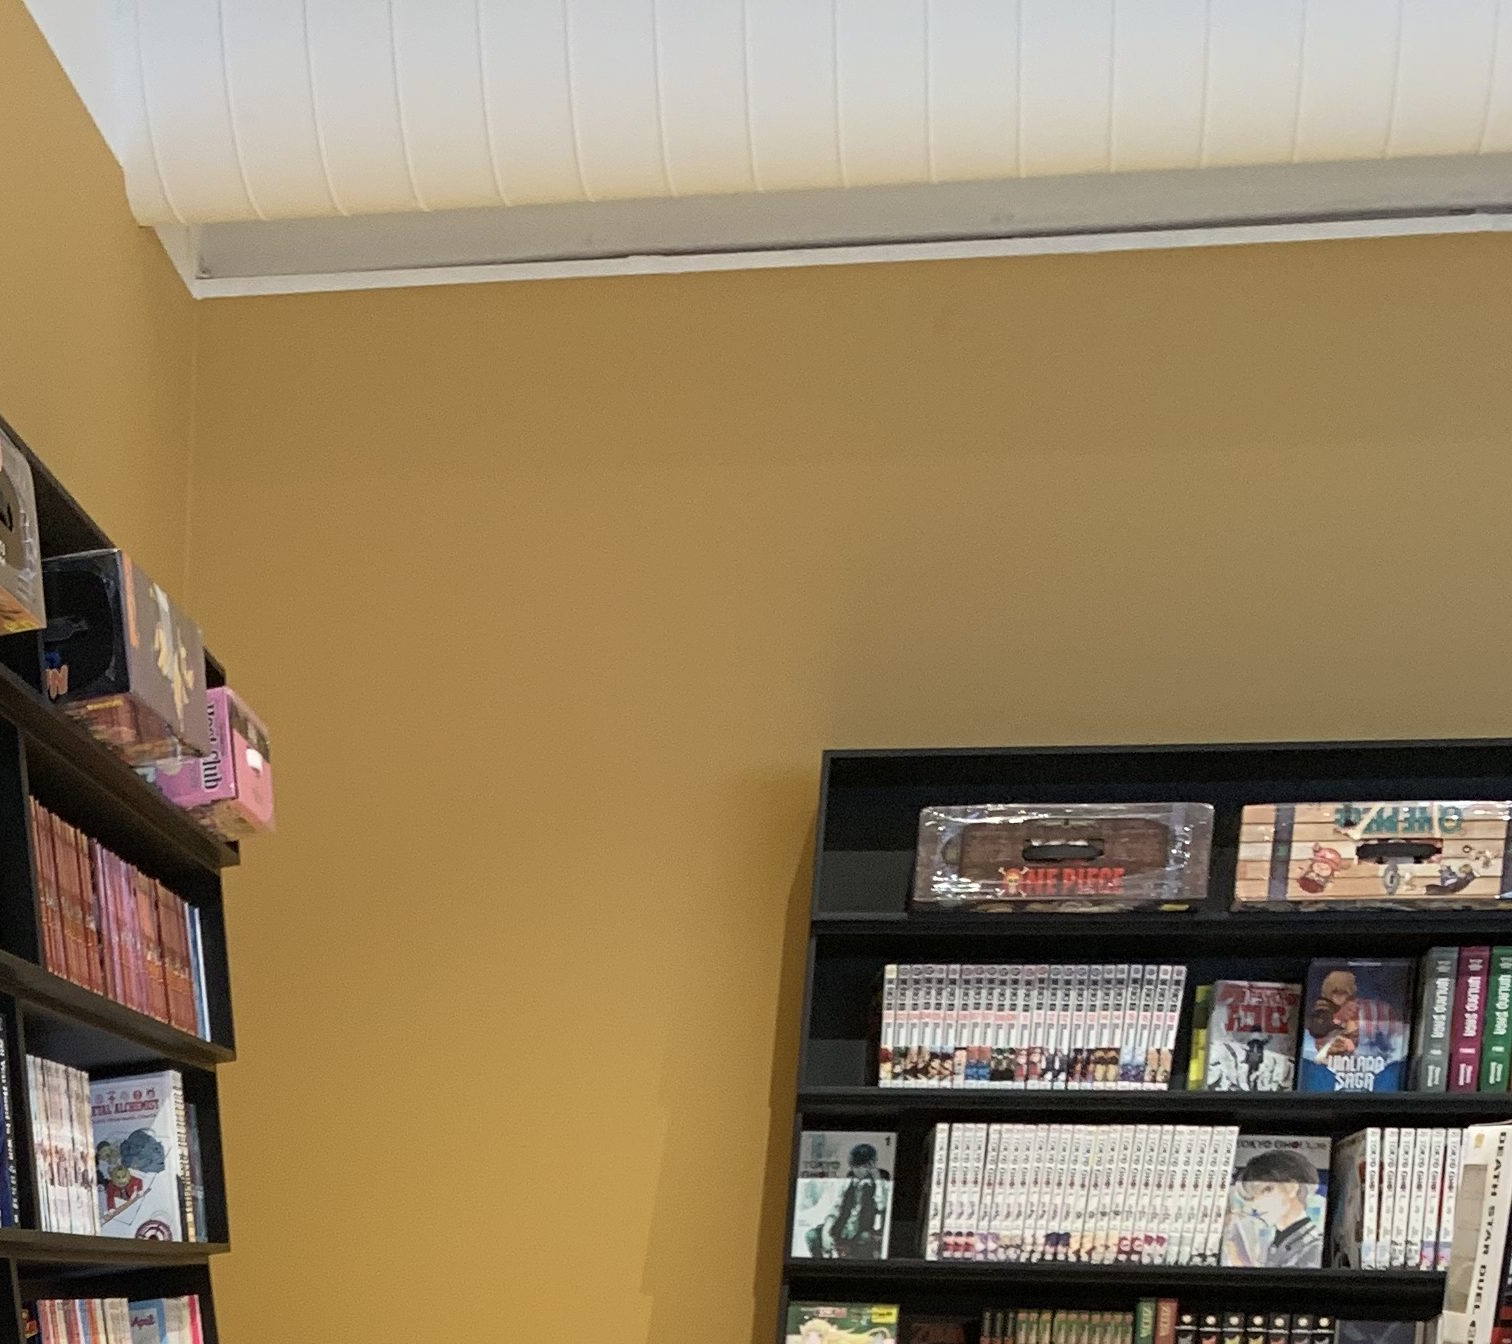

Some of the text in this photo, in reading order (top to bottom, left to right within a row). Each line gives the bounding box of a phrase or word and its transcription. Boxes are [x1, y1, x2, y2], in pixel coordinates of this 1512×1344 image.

[203, 751, 222, 789] Club
[1062, 867, 1126, 895] PIECE
[1334, 1074, 1374, 1091] SAGA
[1492, 1132, 1507, 1197] DEATH
[1482, 1205, 1494, 1255] STAR
